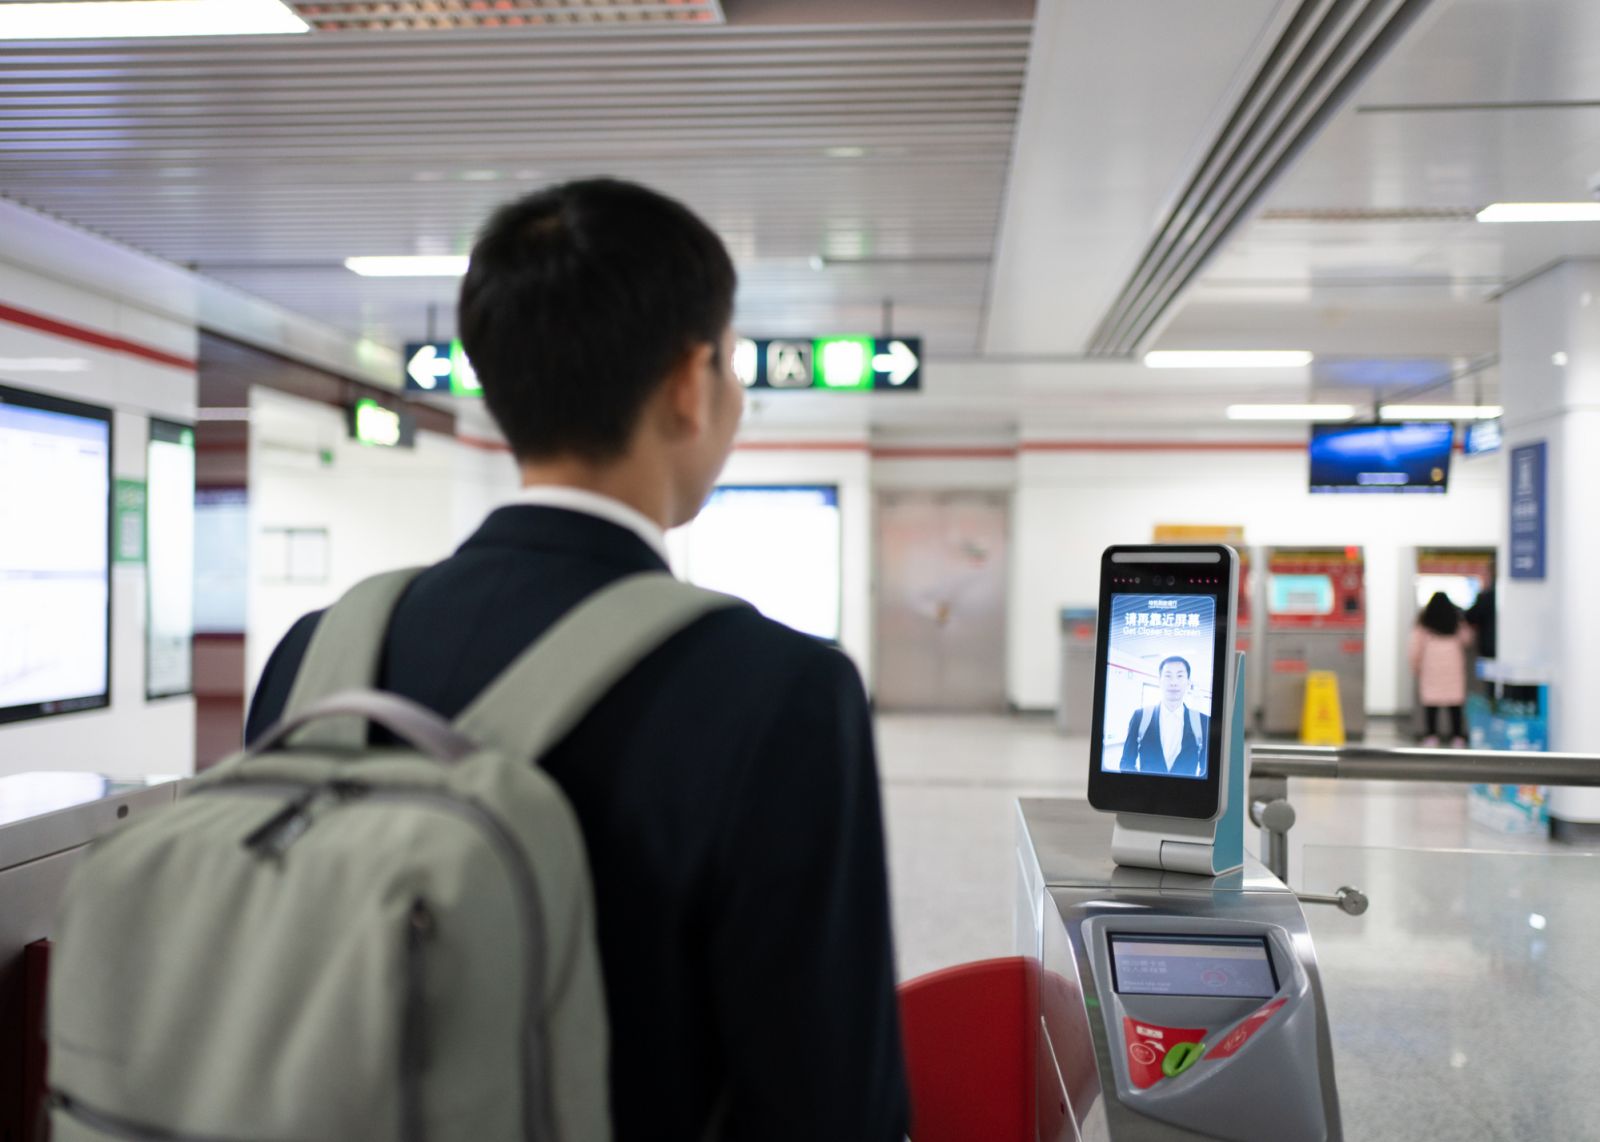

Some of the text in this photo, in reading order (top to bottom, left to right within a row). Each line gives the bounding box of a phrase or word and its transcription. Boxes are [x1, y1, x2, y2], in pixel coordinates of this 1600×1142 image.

[1125, 612, 1200, 627] 请再靠近屏幕
[1123, 626, 1201, 637] Get Closer to Screen
